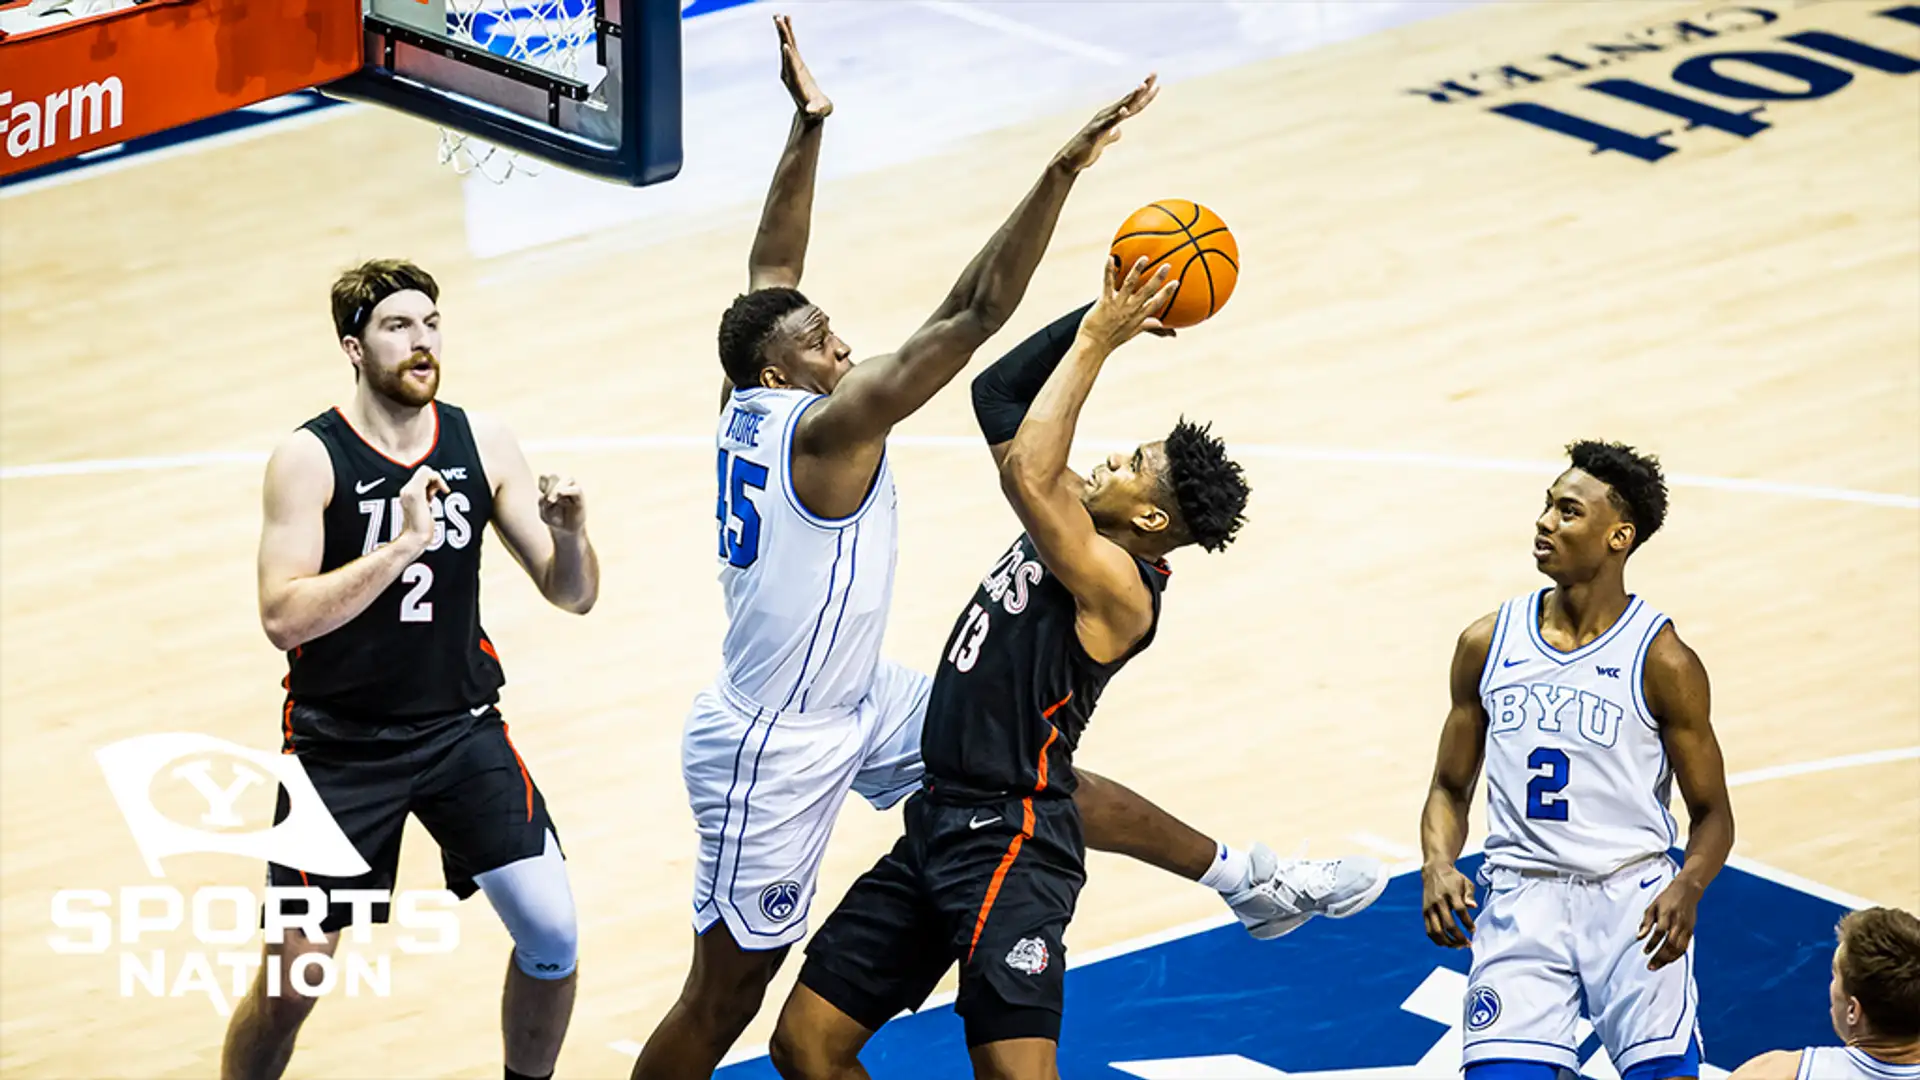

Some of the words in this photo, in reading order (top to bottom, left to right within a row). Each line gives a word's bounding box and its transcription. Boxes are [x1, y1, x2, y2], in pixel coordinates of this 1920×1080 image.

[1408, 6, 1779, 104] CENTER
[359, 491, 472, 556] ZGS
[400, 562, 434, 622] 2
[947, 602, 990, 673] 13
[1596, 665, 1622, 679] WCC
[1491, 683, 1624, 749] BYU
[1526, 746, 1571, 822] 2
